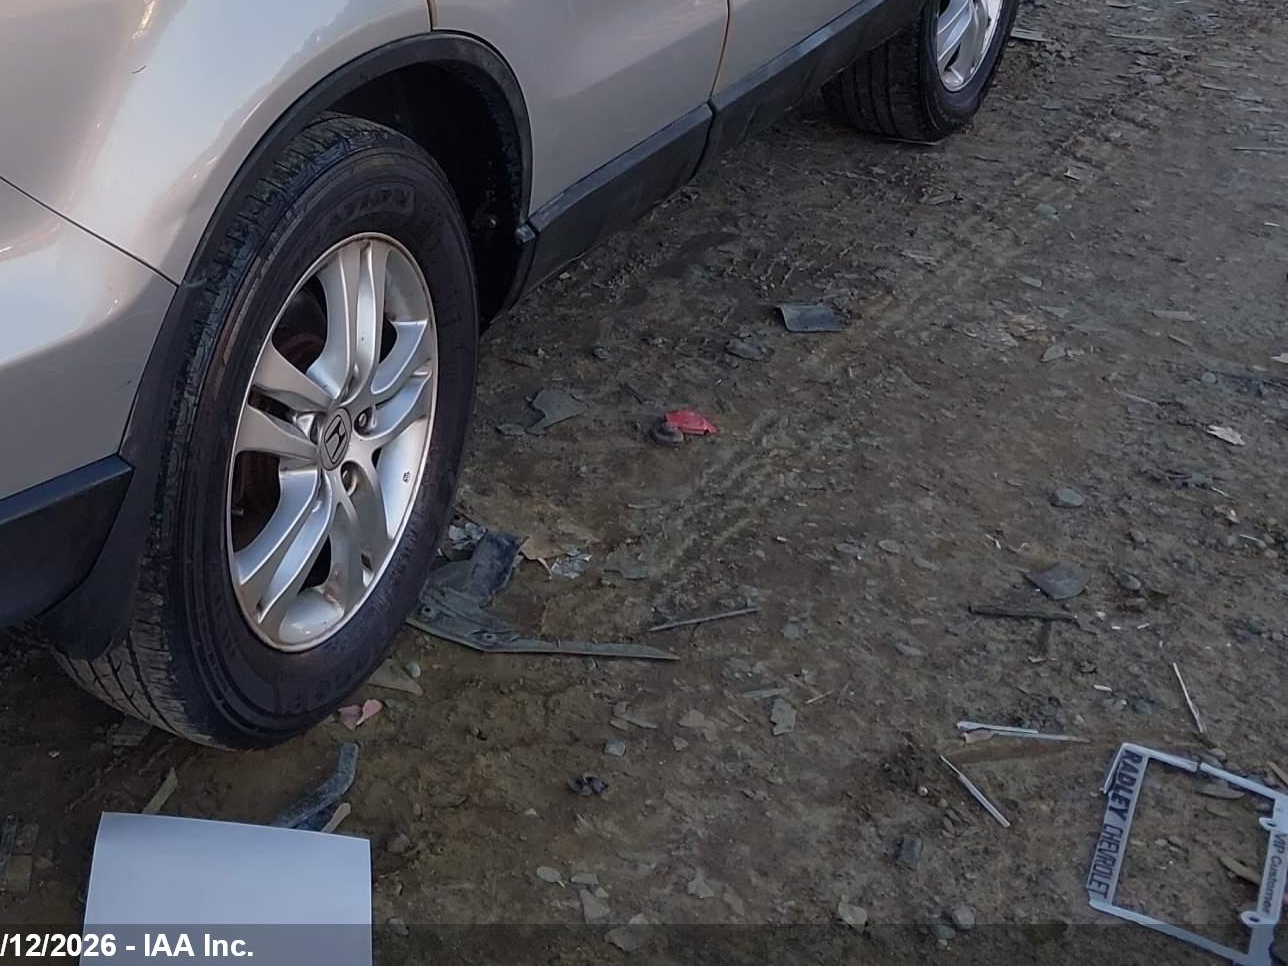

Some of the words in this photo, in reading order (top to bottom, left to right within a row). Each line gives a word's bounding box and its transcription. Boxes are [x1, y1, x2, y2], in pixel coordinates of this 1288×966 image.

[1108, 749, 1143, 822] RADLEY
[1087, 822, 1124, 899] CHEVROLET
[1273, 834, 1287, 854] VIP
[1262, 855, 1283, 914] Customer
